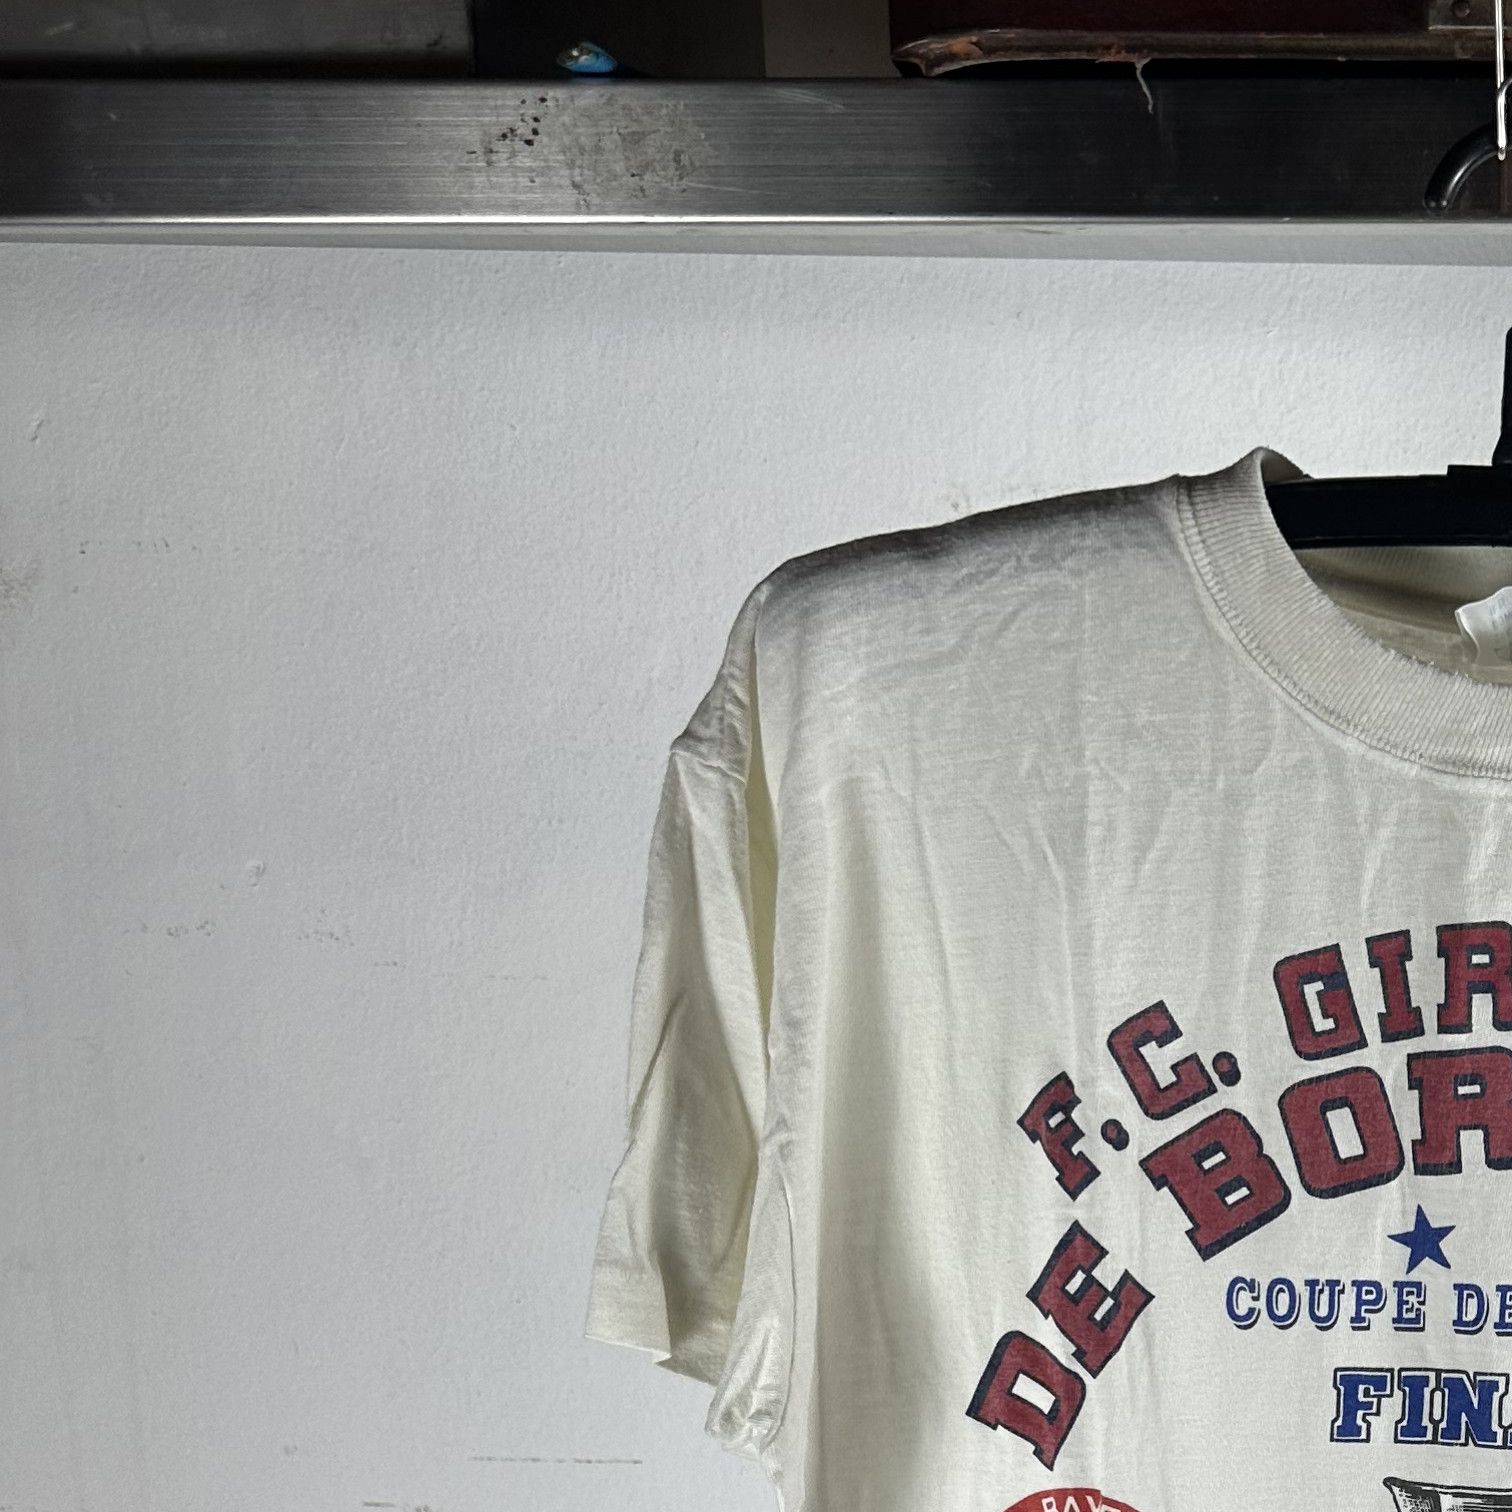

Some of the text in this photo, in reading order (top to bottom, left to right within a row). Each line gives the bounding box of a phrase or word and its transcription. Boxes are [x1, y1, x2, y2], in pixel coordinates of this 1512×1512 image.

[1017, 999, 1240, 1200] F.C.
[965, 1219, 1155, 1471] DE
[1226, 1275, 1426, 1331] COUPE
